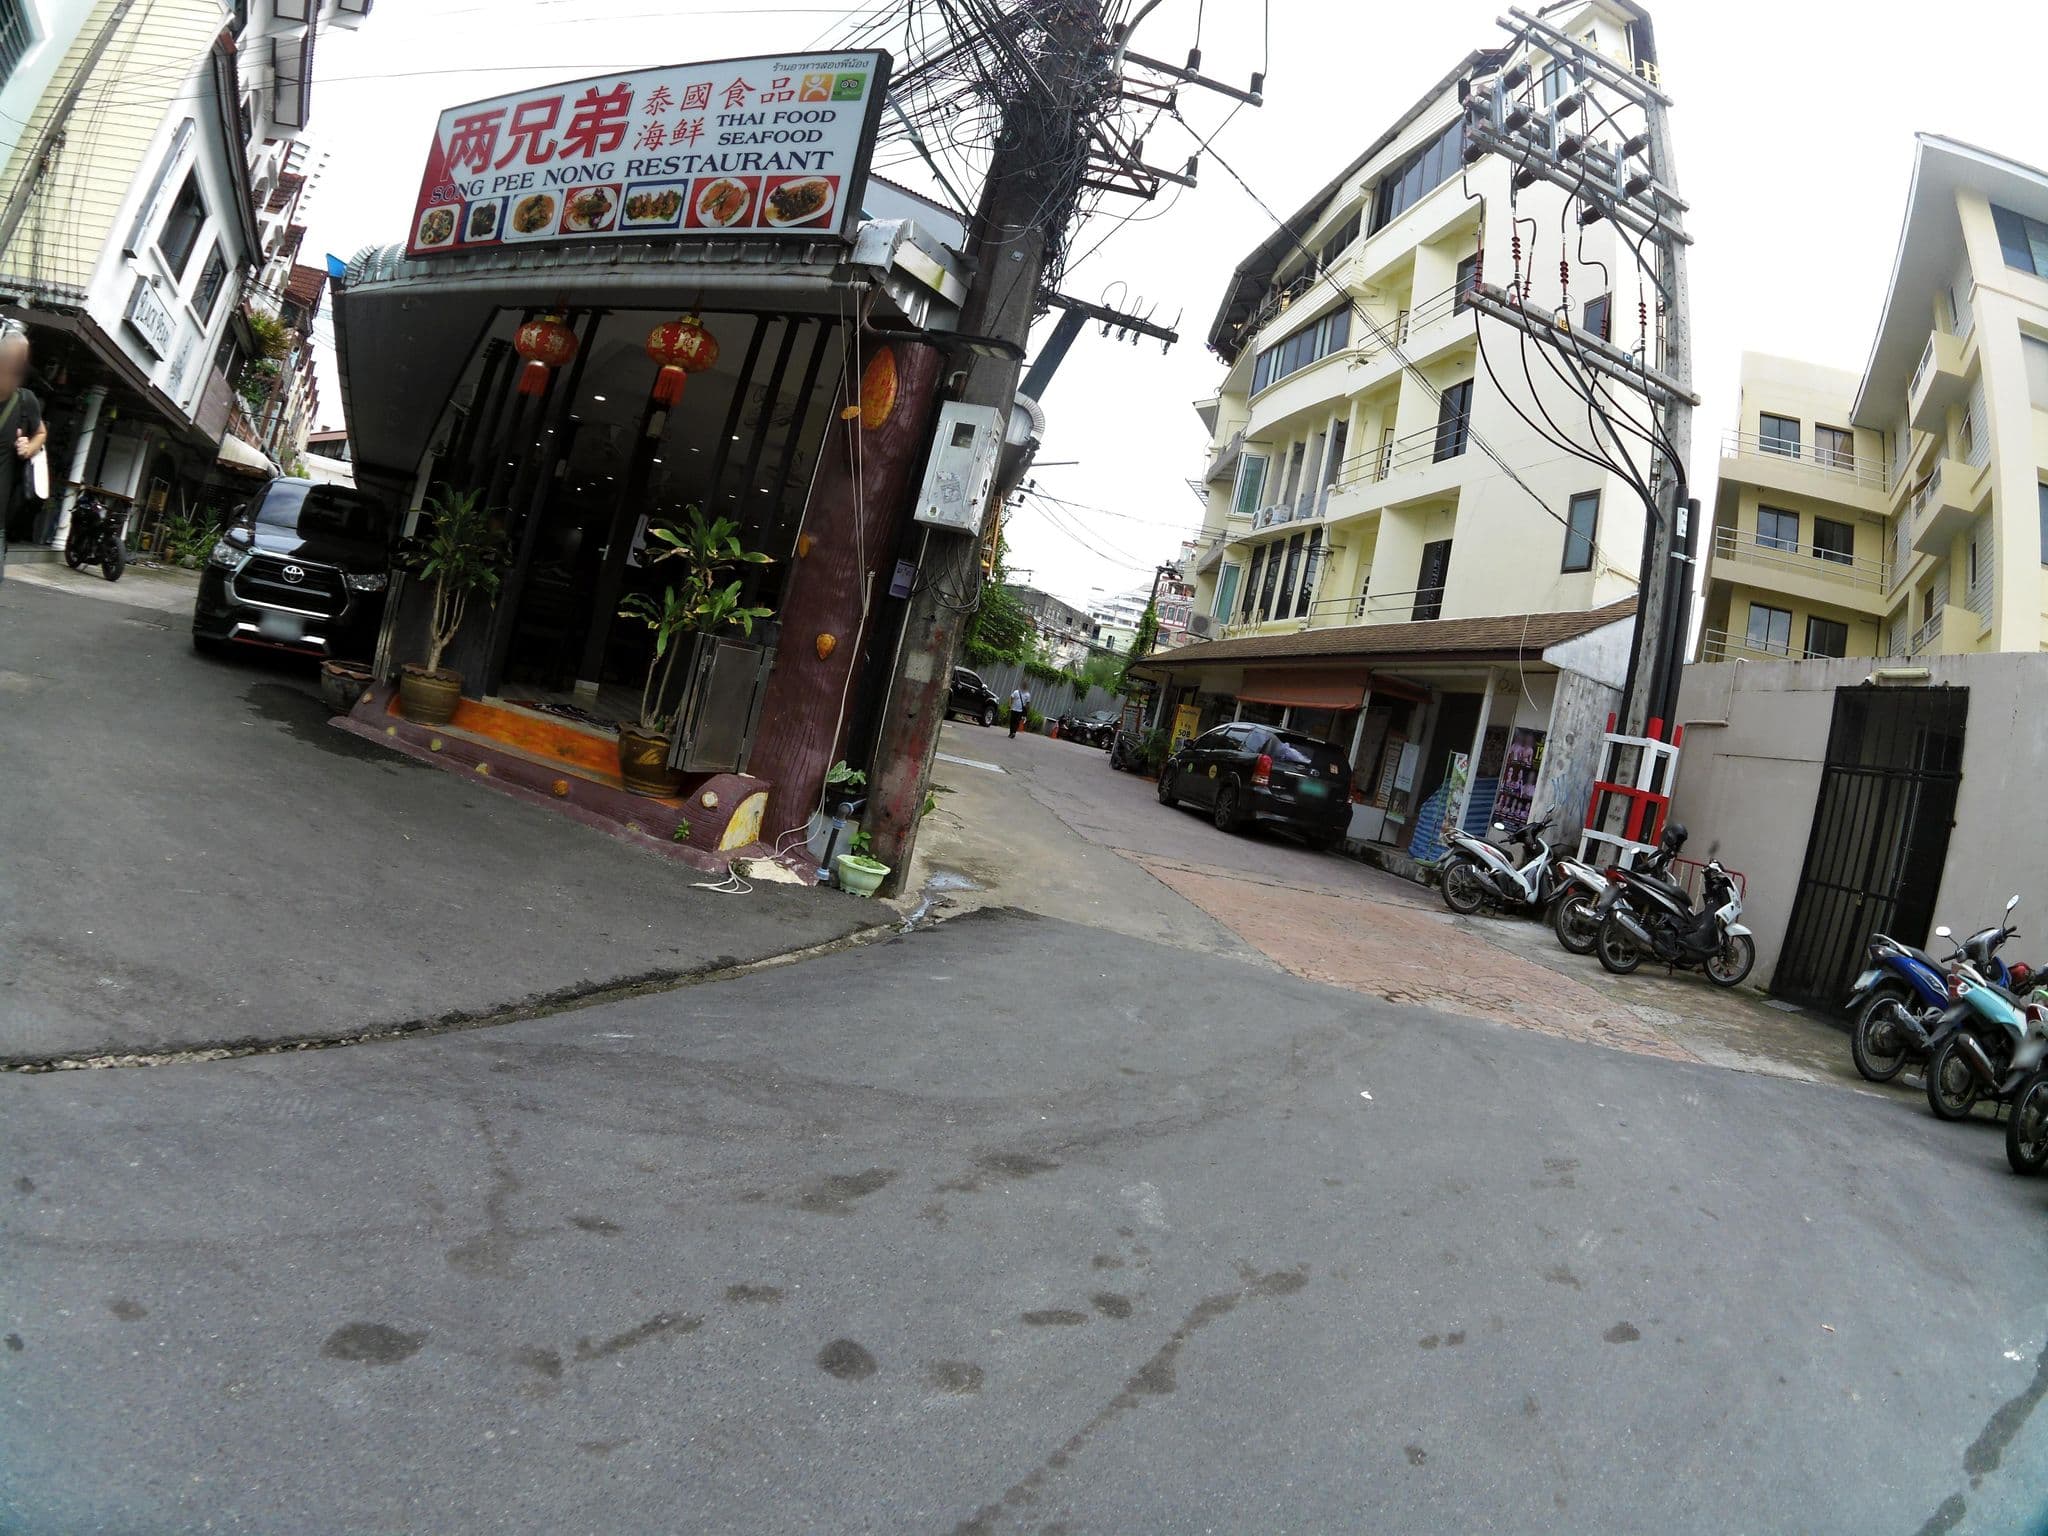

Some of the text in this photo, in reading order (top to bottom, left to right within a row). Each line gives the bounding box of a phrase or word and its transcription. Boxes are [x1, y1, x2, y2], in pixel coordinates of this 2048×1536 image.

[641, 76, 796, 117] 泰國食品
[439, 81, 635, 182] 两兄弟
[633, 116, 705, 152] 海鲜
[716, 109, 836, 127] THAI FOOD
[717, 128, 823, 146] SEAFOOD
[430, 150, 834, 205] SONG PEE NONG RESTAURANT
